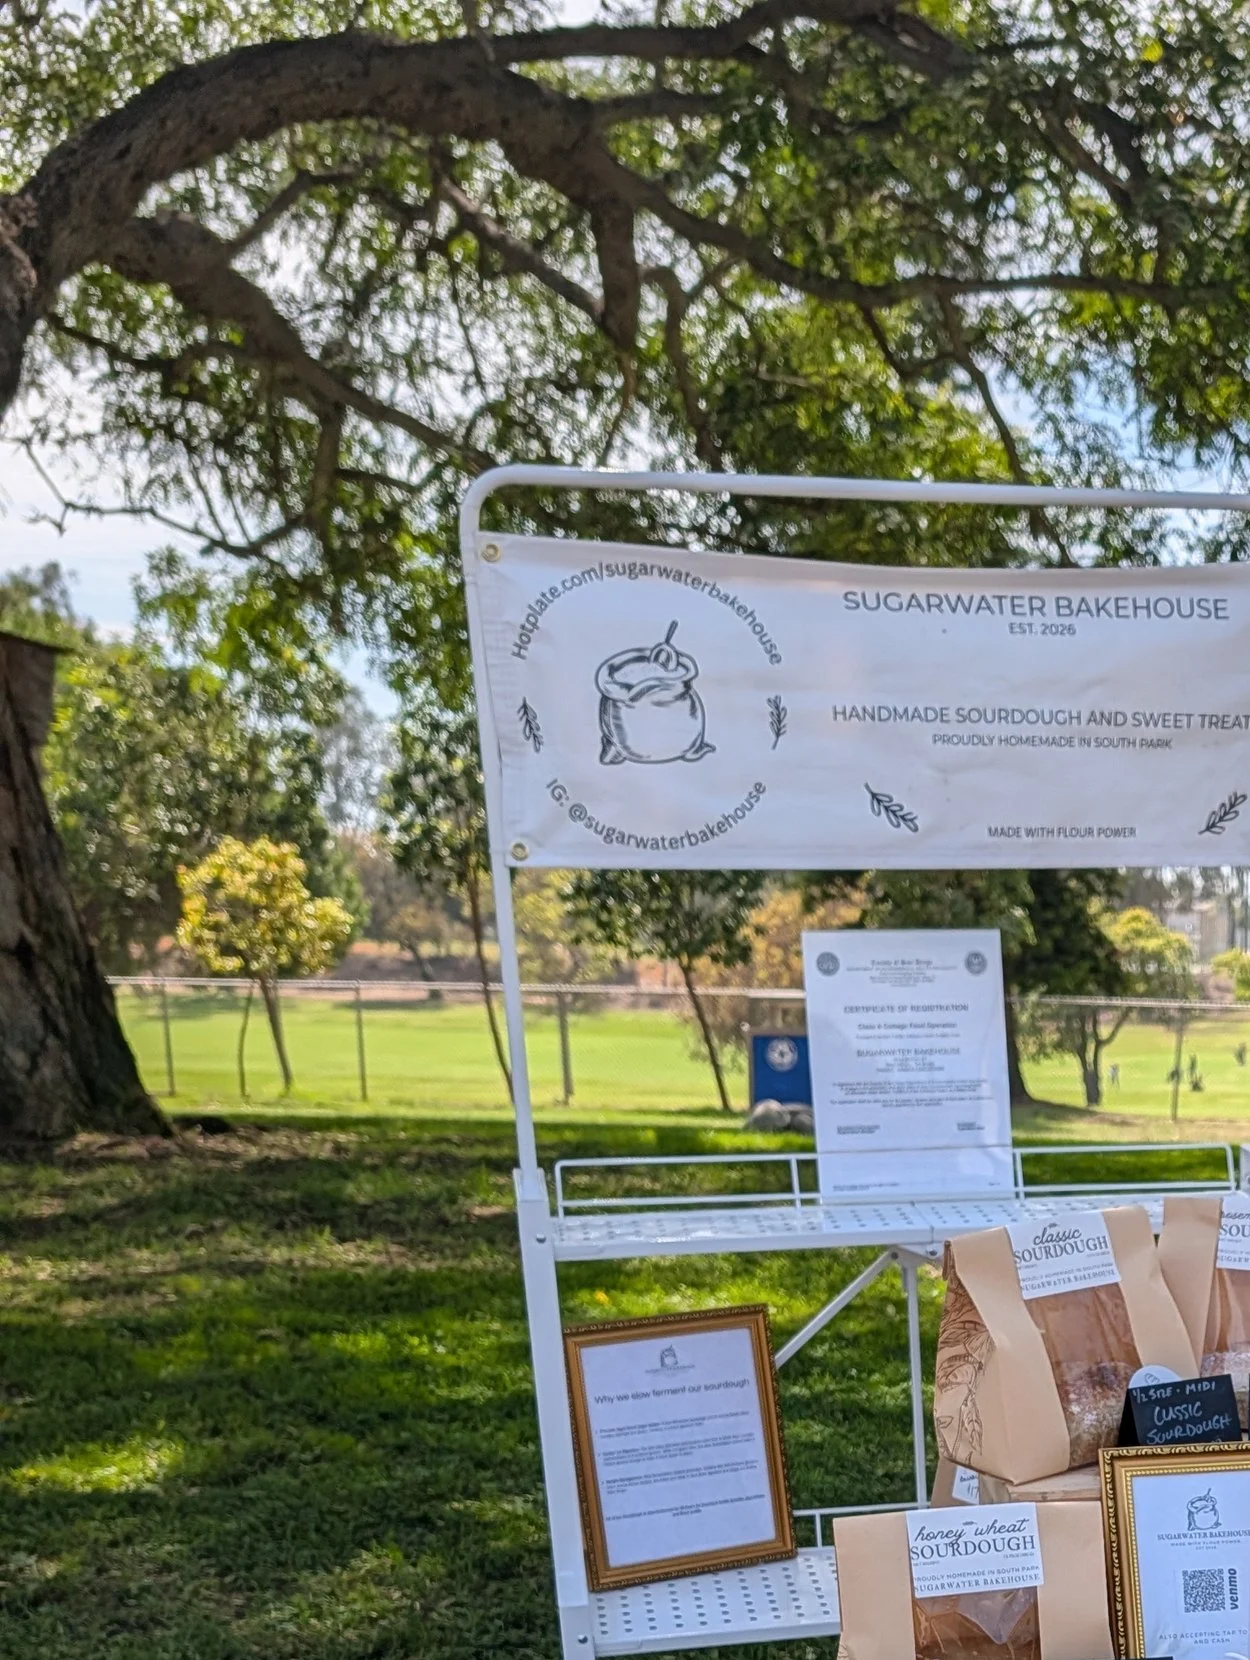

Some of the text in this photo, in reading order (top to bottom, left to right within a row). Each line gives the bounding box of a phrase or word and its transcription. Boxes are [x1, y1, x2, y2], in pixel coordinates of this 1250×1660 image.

[511, 561, 783, 666] Hotplate.com/sugarwaterbakehouse
[842, 590, 1231, 621] SUGARWATER BAKEHOUSE
[1008, 622, 1077, 636] EST. 2026
[832, 704, 950, 723] HANDMADE
[955, 707, 1082, 727] SOURDOUGH
[1086, 710, 1128, 727] AND
[1131, 711, 1194, 729] SWEET
[932, 733, 1173, 750] PROUDLY HOMEMADE IN SOUTH PARK
[545, 778, 767, 851] IG: @sugarwaterbakehouse
[987, 825, 1137, 839] MADE WITH FLOUR POWER
[1033, 1226, 1082, 1246] classic
[1013, 1235, 1109, 1264] SOURDOUGH
[594, 1394, 614, 1405] Why
[616, 1393, 629, 1401] we
[652, 1385, 686, 1396] ferment
[688, 1384, 702, 1393] our
[704, 1378, 750, 1392] sourdough
[1149, 1386, 1173, 1401] SIZE
[1185, 1381, 1216, 1395] MIDI
[1146, 1413, 1233, 1445] SOURDOUGH
[914, 1518, 1030, 1546] honey wheat
[1157, 1532, 1208, 1541] SUGARWATER
[910, 1535, 1036, 1561] SOURDOUGH
[946, 1570, 986, 1580] HOMEMADE
[997, 1567, 1020, 1575] SOUTH
[983, 1573, 1040, 1585] BAKEHOUSE
[1228, 1568, 1240, 1610] venmo
[1180, 1630, 1221, 1639] ACCEPTING
